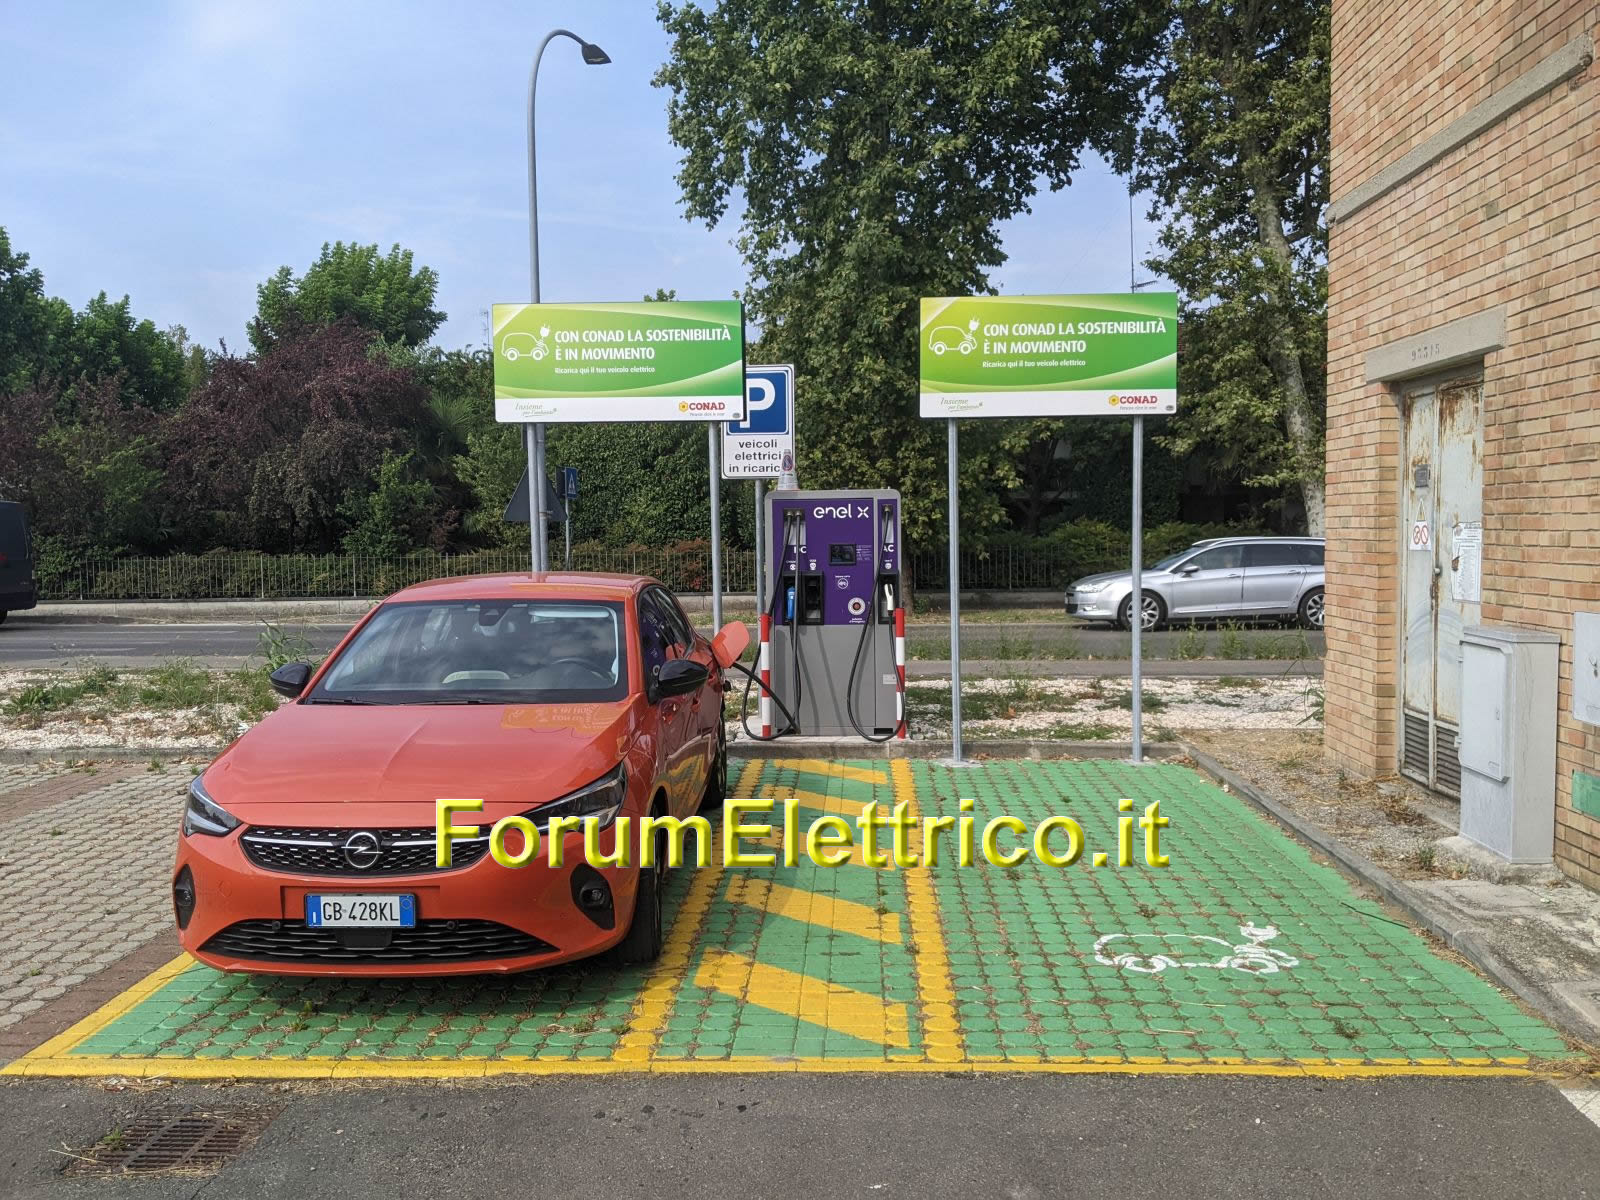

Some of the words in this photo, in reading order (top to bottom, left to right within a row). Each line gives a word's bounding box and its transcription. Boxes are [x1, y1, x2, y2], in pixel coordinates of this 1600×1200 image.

[983, 323, 1009, 336] CON
[1012, 322, 1055, 336] CONAD
[1058, 322, 1075, 335] LA
[1077, 317, 1166, 335] SOSTENIBILITÀ
[554, 330, 579, 343] CON
[582, 329, 625, 342] CONAD
[627, 329, 644, 342] LA
[646, 324, 731, 342] SOSTENIBILITÀ
[983, 339, 991, 354] È
[993, 341, 1007, 354] IN
[1010, 339, 1087, 354] MOVIMENTO
[555, 345, 562, 361] È
[565, 348, 578, 360] IN
[581, 347, 655, 360] MOVIMENTO
[1008, 360, 1018, 369] qui
[1037, 359, 1059, 367] veicolo
[1060, 359, 1086, 367] elettrico
[579, 366, 590, 375] qui
[591, 366, 595, 374] il
[596, 366, 607, 374] tuo
[740, 378, 776, 429] P
[1120, 395, 1158, 404] CONAD
[689, 402, 726, 411] CONAD
[738, 439, 778, 449] veicoli
[735, 451, 781, 461] elettrici
[729, 464, 739, 472] in
[743, 464, 780, 473] ricaric
[813, 503, 852, 519] enel
